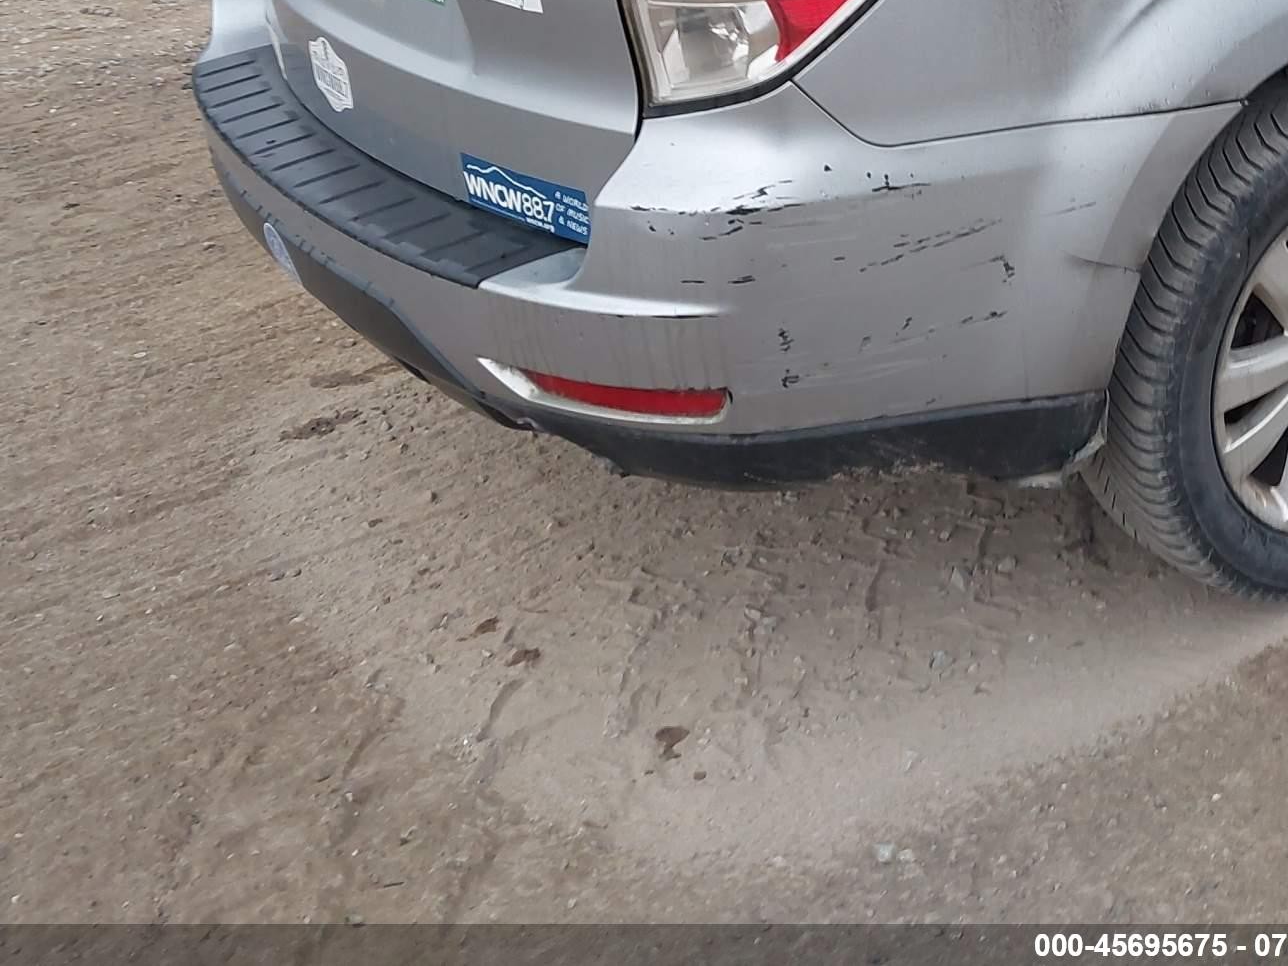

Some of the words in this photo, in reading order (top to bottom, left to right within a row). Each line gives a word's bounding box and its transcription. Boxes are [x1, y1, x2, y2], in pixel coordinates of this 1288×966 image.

[562, 195, 589, 212] WORLD
[566, 208, 590, 224] MUSIC
[566, 220, 588, 236] NEWS
